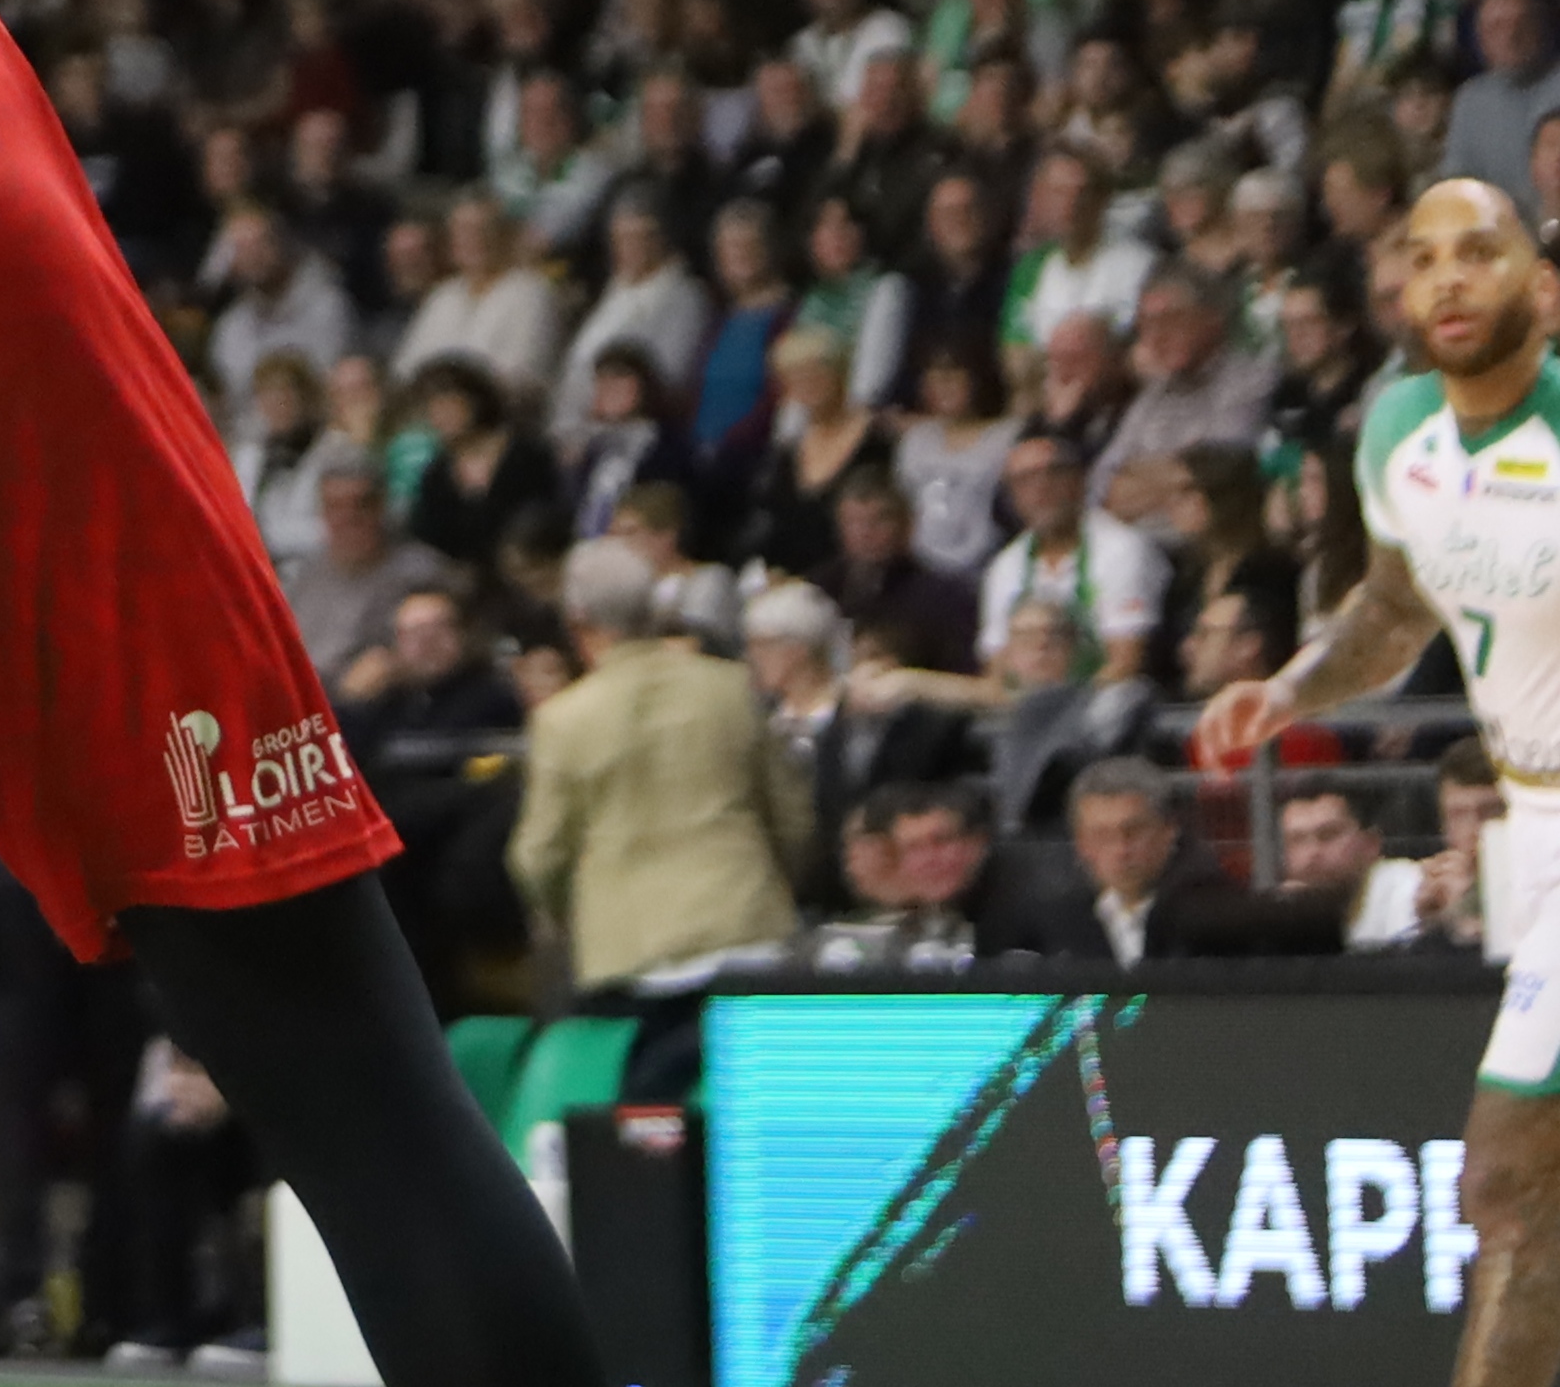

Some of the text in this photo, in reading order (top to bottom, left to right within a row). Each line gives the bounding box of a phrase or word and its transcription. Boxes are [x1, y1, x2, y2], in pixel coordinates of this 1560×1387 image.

[1461, 605, 1494, 677] 7
[252, 713, 327, 759] GROUPE
[184, 785, 358, 859] BÂTIMEN
[1119, 1134, 1480, 1314] KAPP
